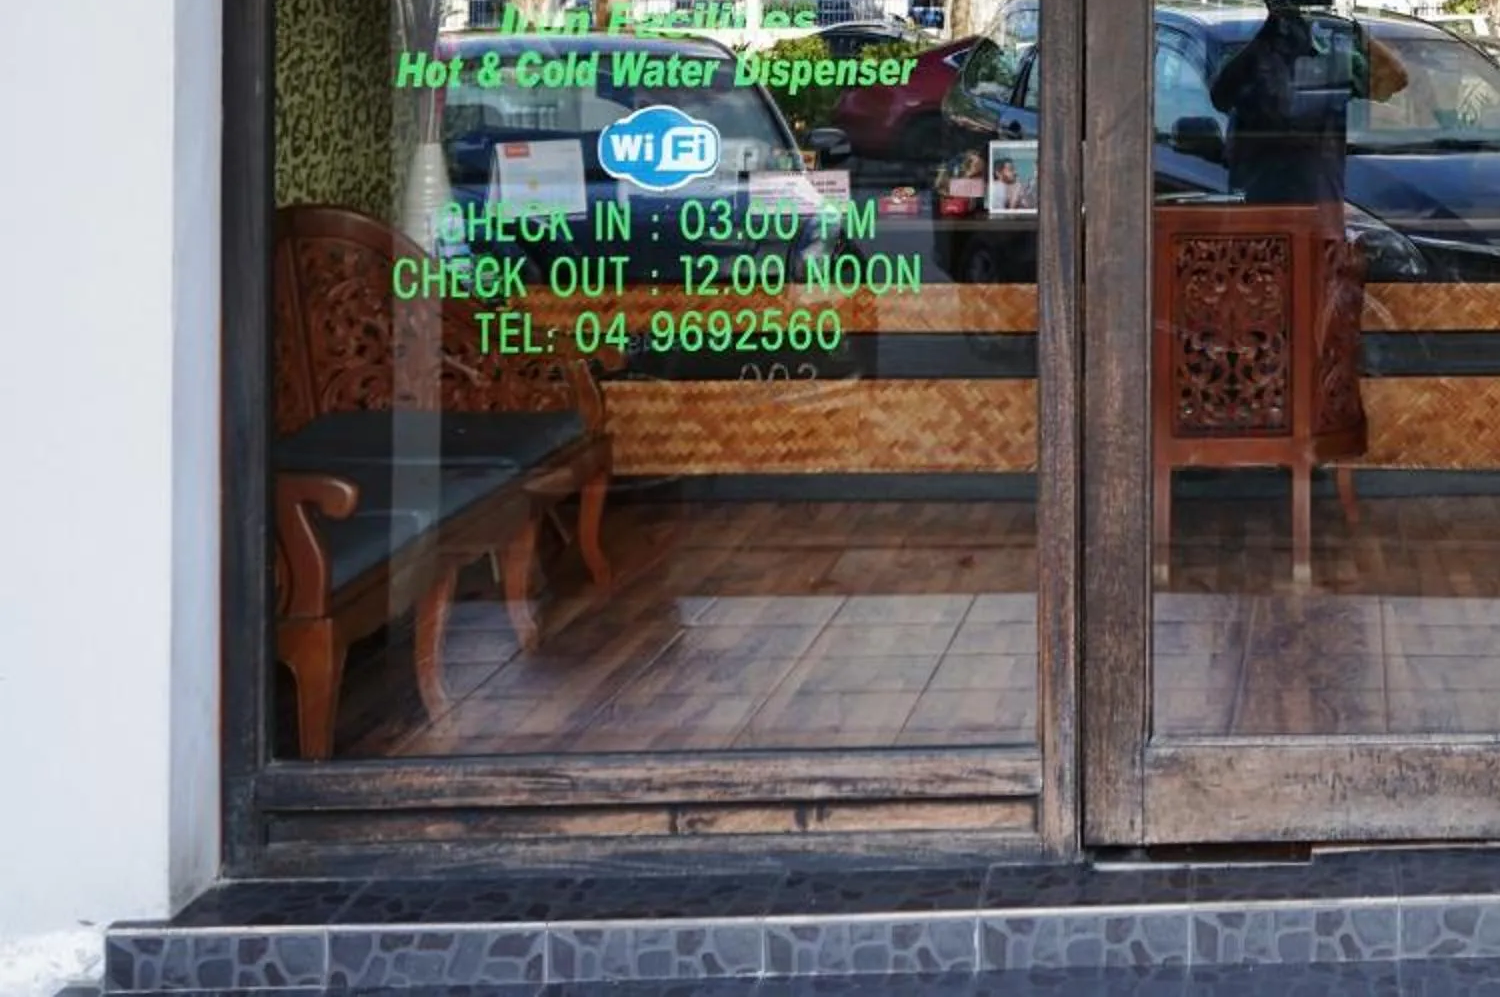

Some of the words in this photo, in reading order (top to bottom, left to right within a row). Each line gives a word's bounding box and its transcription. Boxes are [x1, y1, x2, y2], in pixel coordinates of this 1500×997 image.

[397, 51, 464, 89] Hot
[477, 51, 502, 89] &
[516, 50, 600, 89] Cold
[611, 51, 720, 89] Water
[733, 51, 919, 96] Dispenser
[438, 200, 573, 243] CHECK
[594, 199, 631, 242] IN
[680, 198, 800, 242] 03.00
[818, 199, 877, 241] PM
[392, 255, 529, 300] CHECK
[549, 254, 631, 298] OUT
[679, 253, 786, 297] 12.00
[804, 253, 922, 296] NOON
[473, 310, 556, 354] TEL:
[574, 308, 631, 354] 04
[649, 307, 844, 353] 9692560
